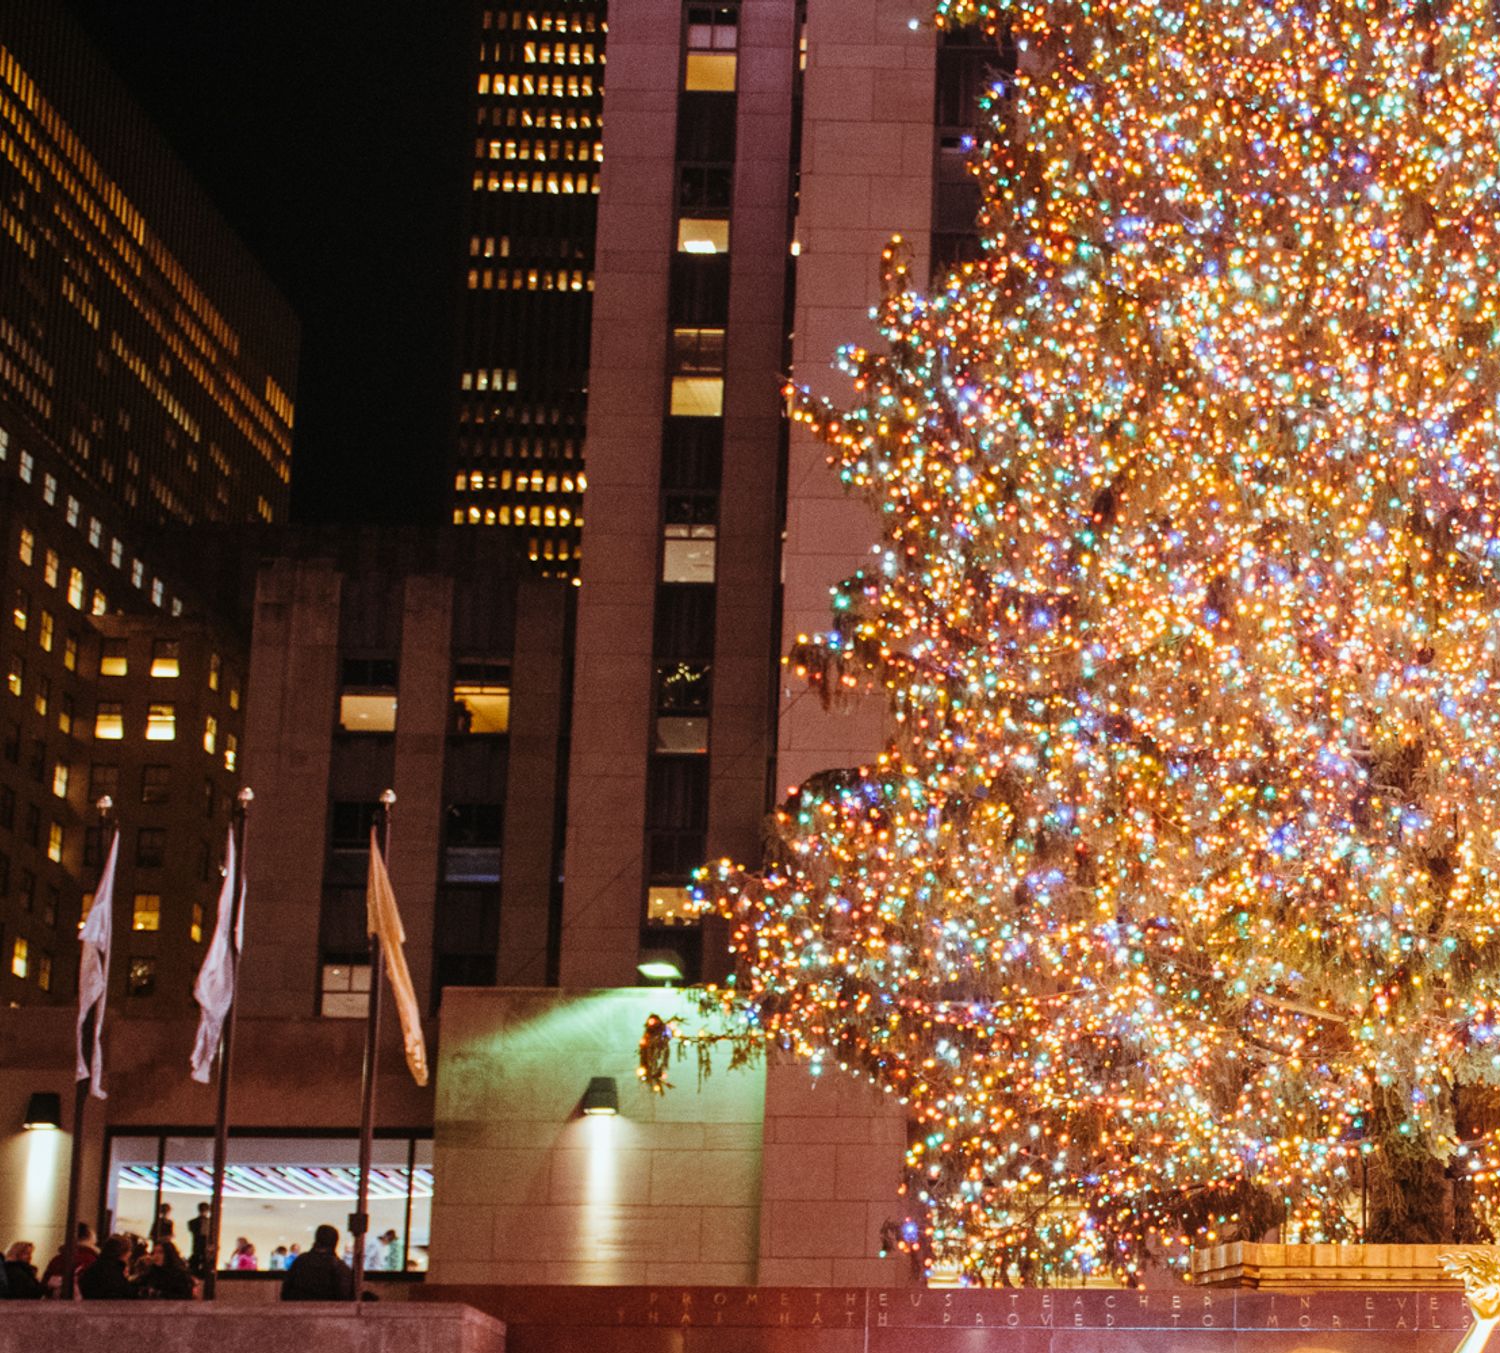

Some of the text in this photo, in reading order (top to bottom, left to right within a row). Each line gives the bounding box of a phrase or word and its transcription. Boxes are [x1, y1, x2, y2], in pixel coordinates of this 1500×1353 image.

[650, 1292, 952, 1307] PROMETHEUS
[1008, 1294, 1212, 1309] TEACHER
[1271, 1295, 1311, 1310] IN
[1365, 1296, 1470, 1311] EVER
[779, 1311, 888, 1327] HATH
[943, 1313, 1115, 1327] PROVED
[1171, 1314, 1214, 1327] TO
[1266, 1315, 1469, 1329] MORTALS
